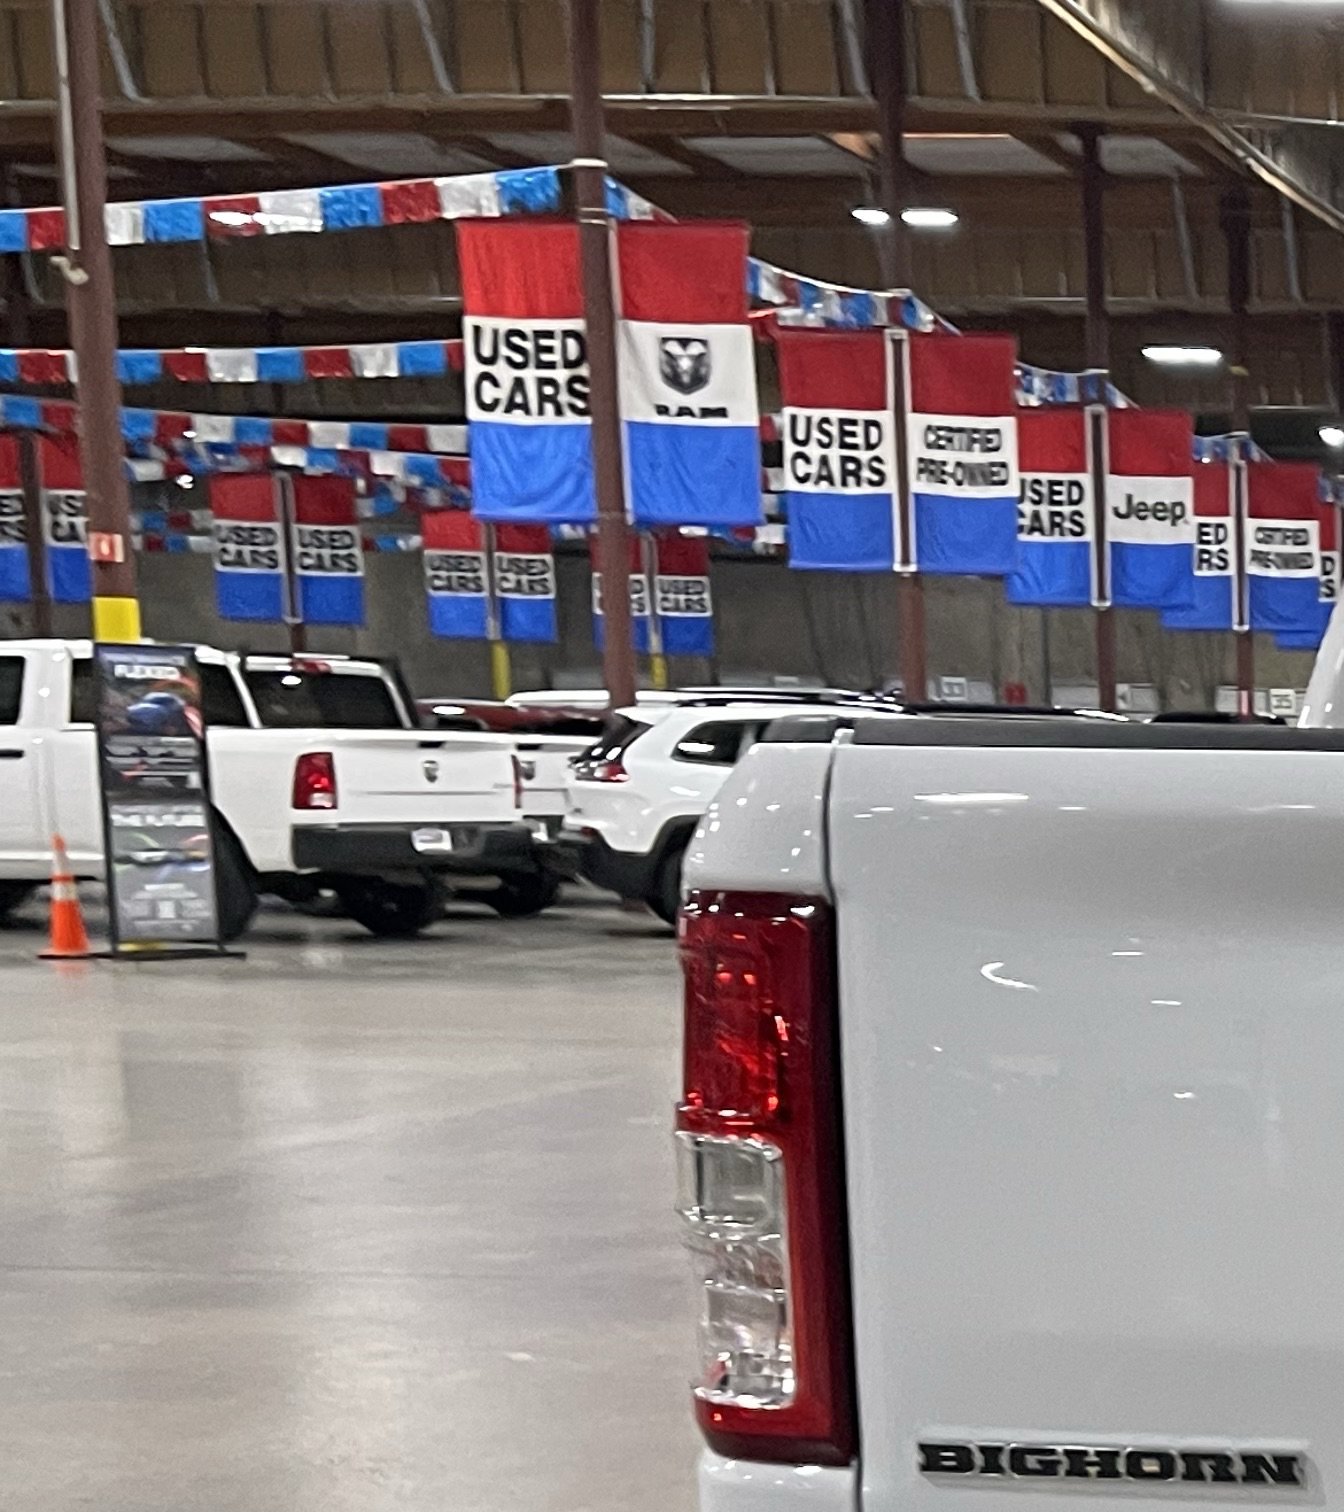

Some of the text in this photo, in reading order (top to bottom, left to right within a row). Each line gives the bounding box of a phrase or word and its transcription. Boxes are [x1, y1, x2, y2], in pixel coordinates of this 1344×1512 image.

[473, 325, 588, 370] USED
[474, 372, 591, 417] CARS
[654, 404, 729, 418] RAM
[790, 415, 883, 451] USED
[924, 425, 1002, 452] CERTIFIED
[790, 452, 887, 488] CARS
[917, 457, 1009, 487] PRE-OWNED
[1112, 493, 1187, 527] Jeep
[216, 525, 278, 546] USED
[298, 528, 355, 549] USED
[219, 547, 279, 569] CARS
[299, 551, 358, 573] CARS
[917, 1442, 1302, 1484] BIGHORN
